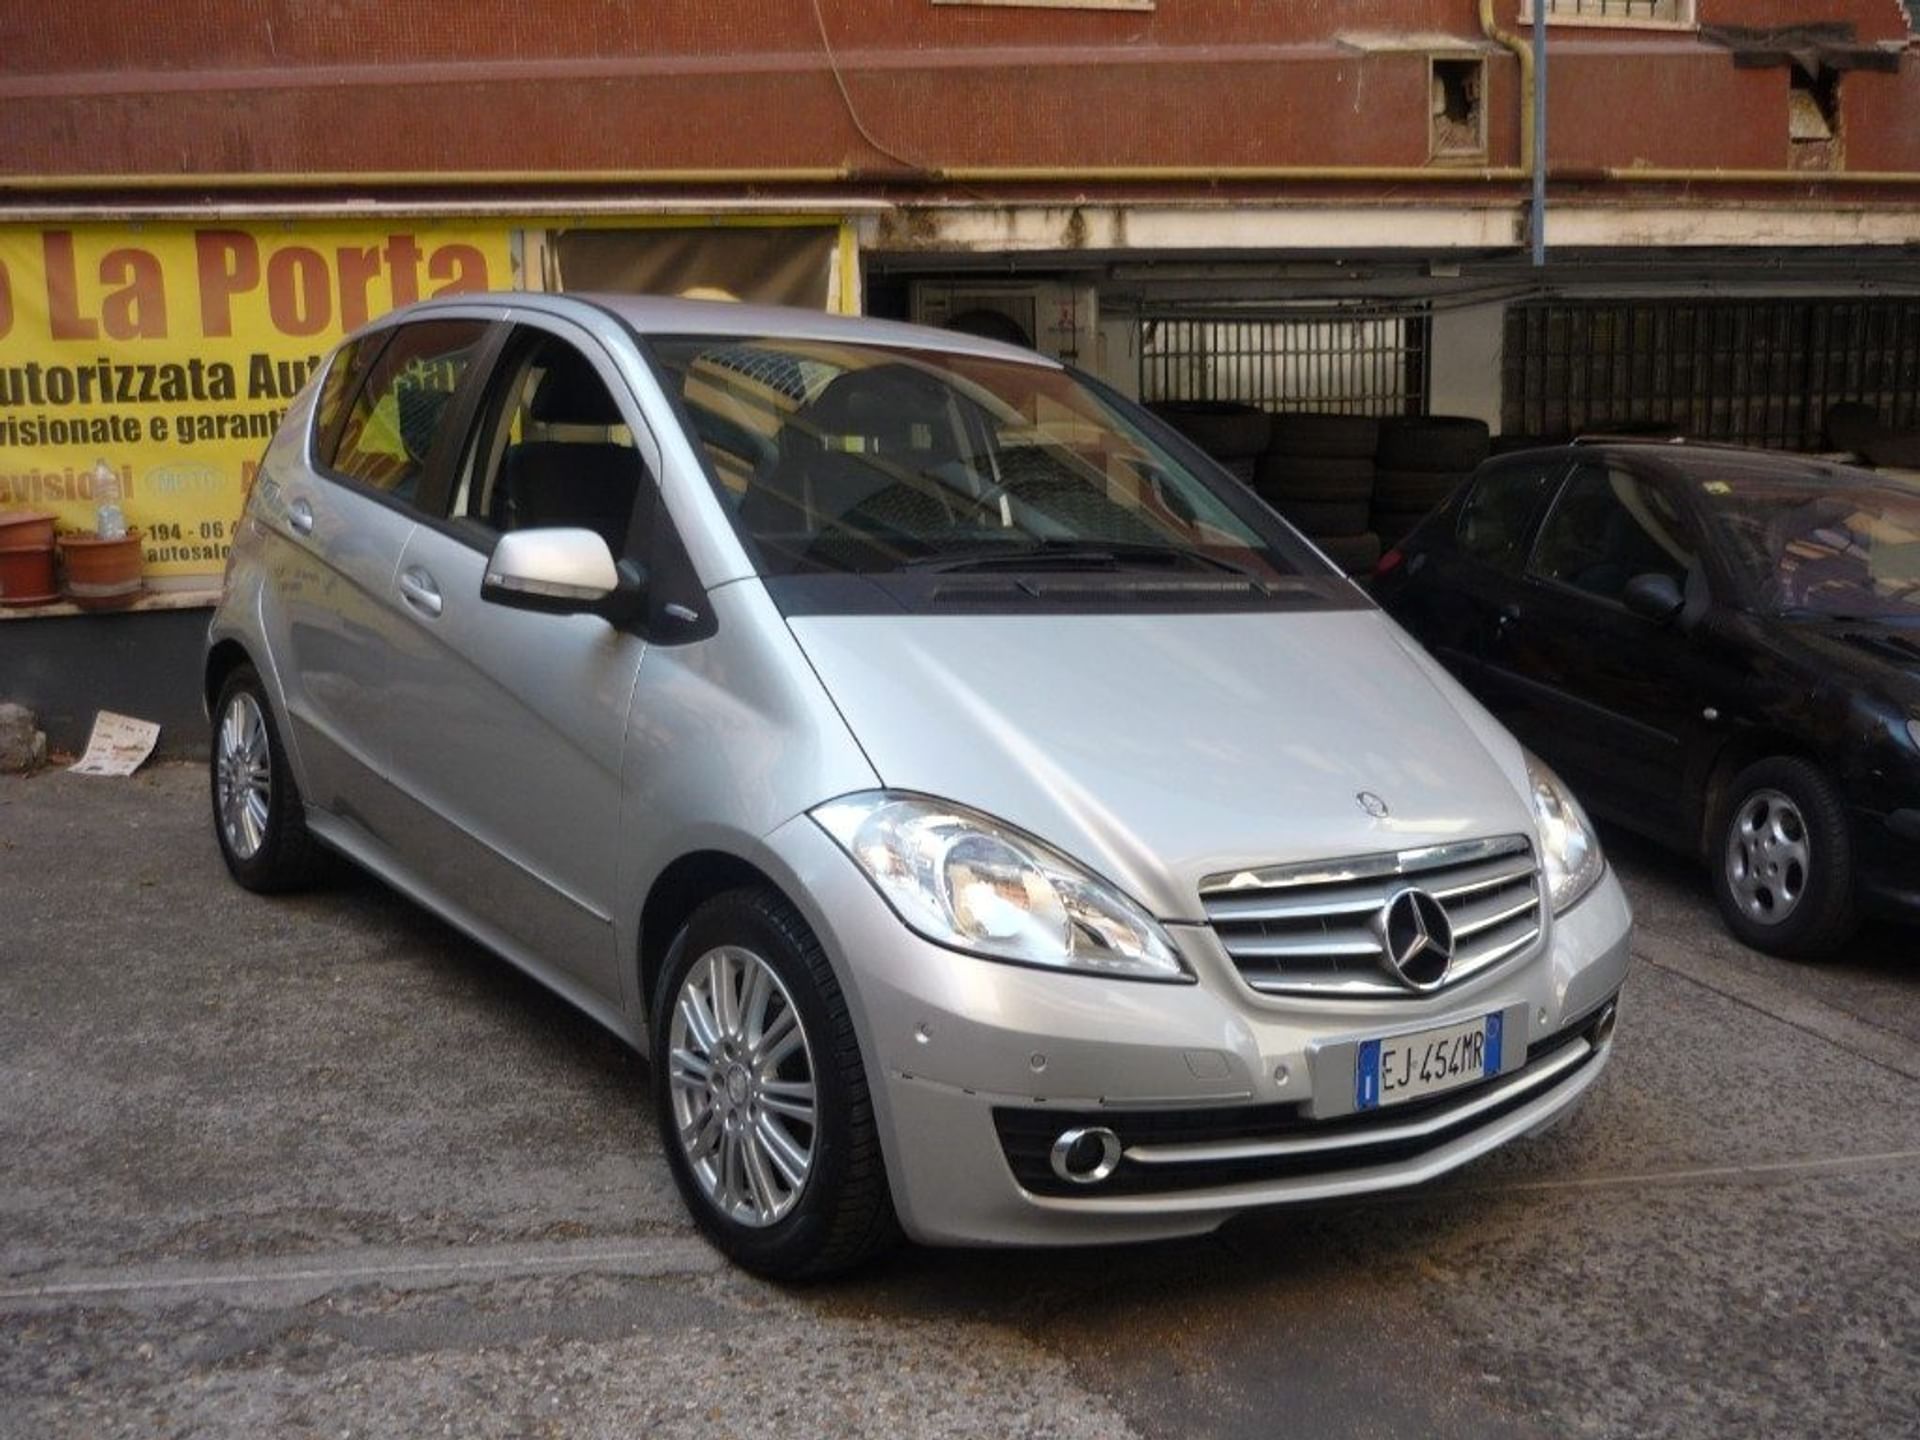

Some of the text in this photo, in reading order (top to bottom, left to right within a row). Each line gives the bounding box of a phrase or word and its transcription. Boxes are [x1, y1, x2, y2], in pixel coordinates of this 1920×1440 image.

[43, 231, 168, 341] La
[195, 229, 490, 338] Porta
[0, 357, 237, 407] utorizzata
[150, 415, 169, 442] e
